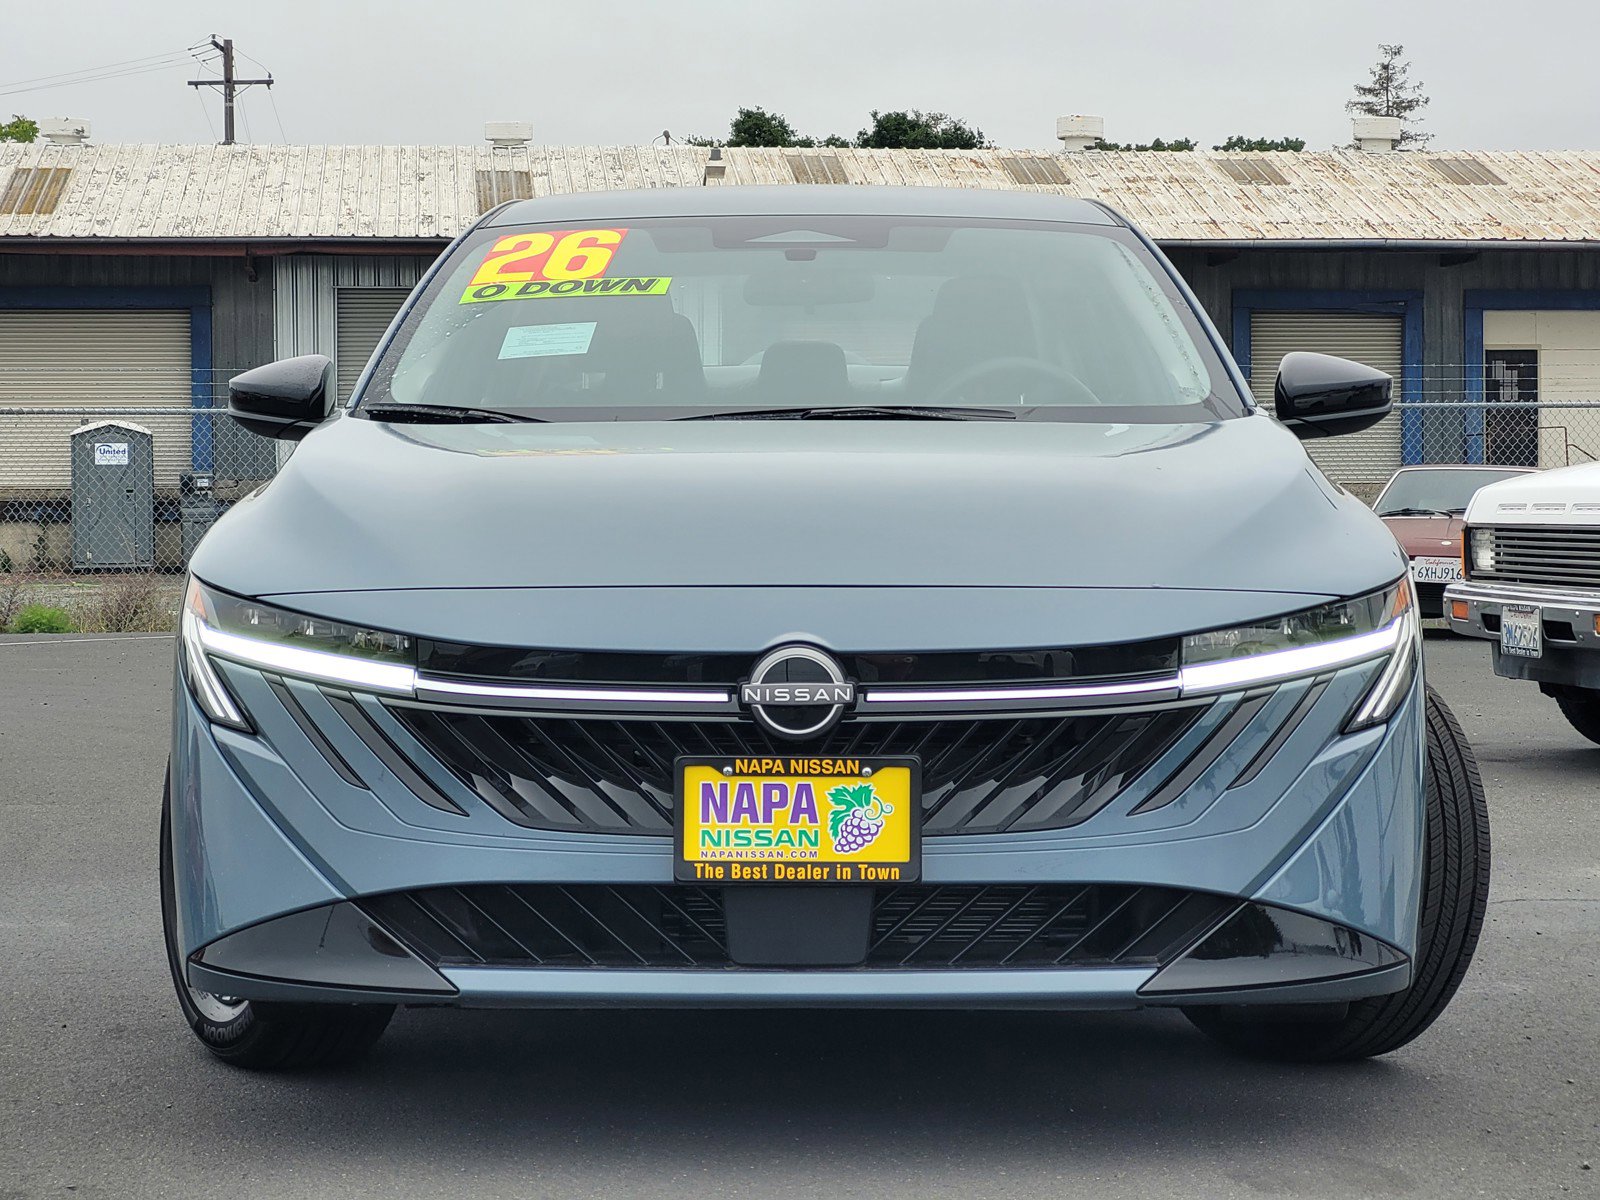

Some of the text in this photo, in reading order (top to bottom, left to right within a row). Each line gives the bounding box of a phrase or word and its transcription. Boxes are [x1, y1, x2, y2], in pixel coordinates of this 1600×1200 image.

[471, 229, 622, 285] 26
[515, 278, 660, 297] DOWN
[99, 447, 126, 455] United
[1417, 566, 1462, 580] 6XHJ916
[744, 688, 850, 701] NISSAN
[735, 759, 860, 775] NAPA NISSAN
[701, 782, 819, 824] NAPA
[701, 829, 819, 848] NISSAN
[700, 850, 818, 859] NAPANISSAN.COM
[694, 863, 900, 880] The Best Dealer in Town
